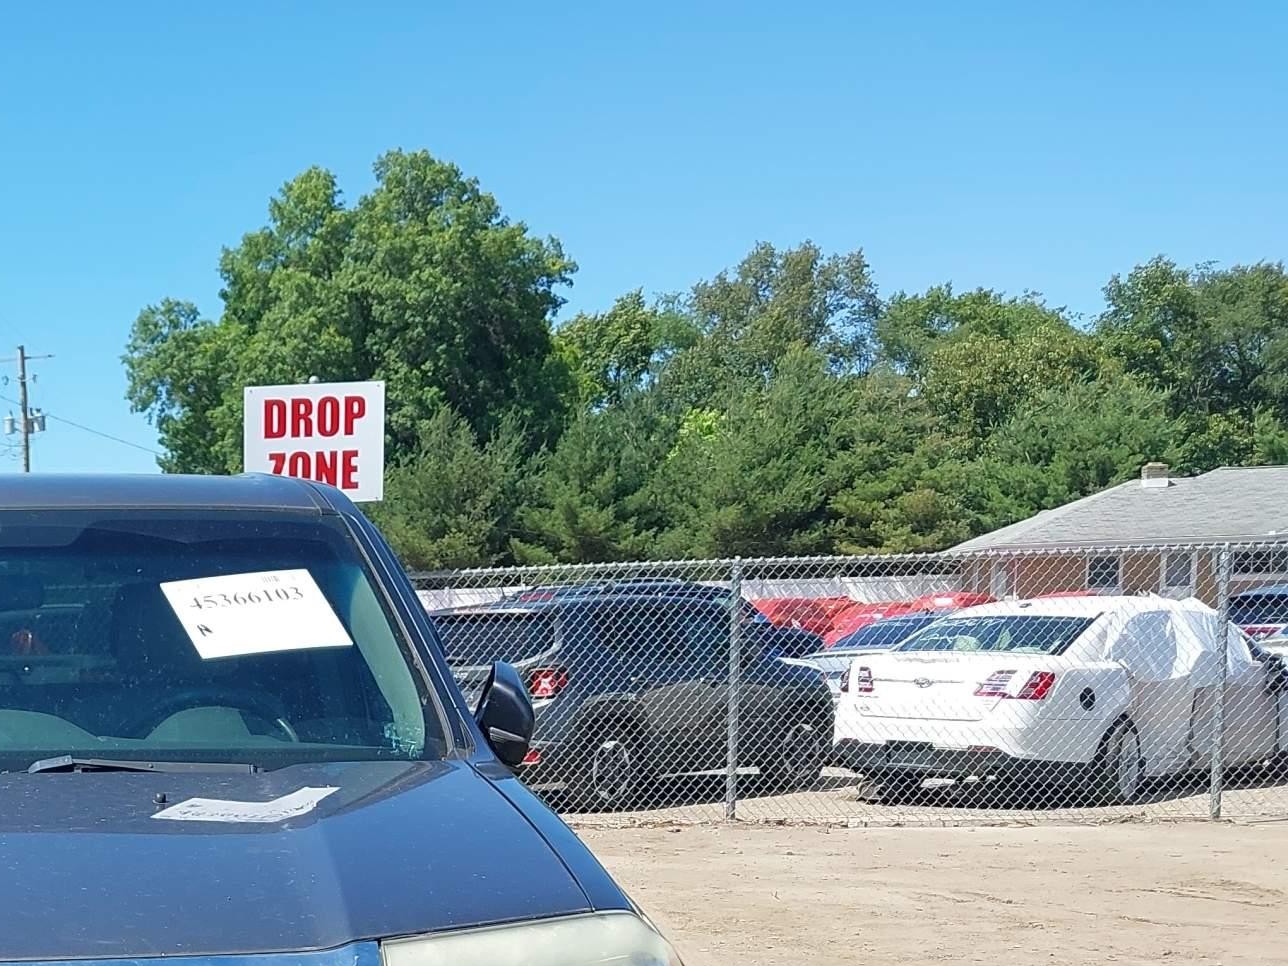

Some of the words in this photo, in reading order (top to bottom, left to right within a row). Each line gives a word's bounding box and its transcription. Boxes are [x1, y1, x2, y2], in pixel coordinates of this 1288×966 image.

[264, 396, 366, 439] DROP
[268, 449, 359, 490] ZONE
[189, 586, 305, 610] 45366103
